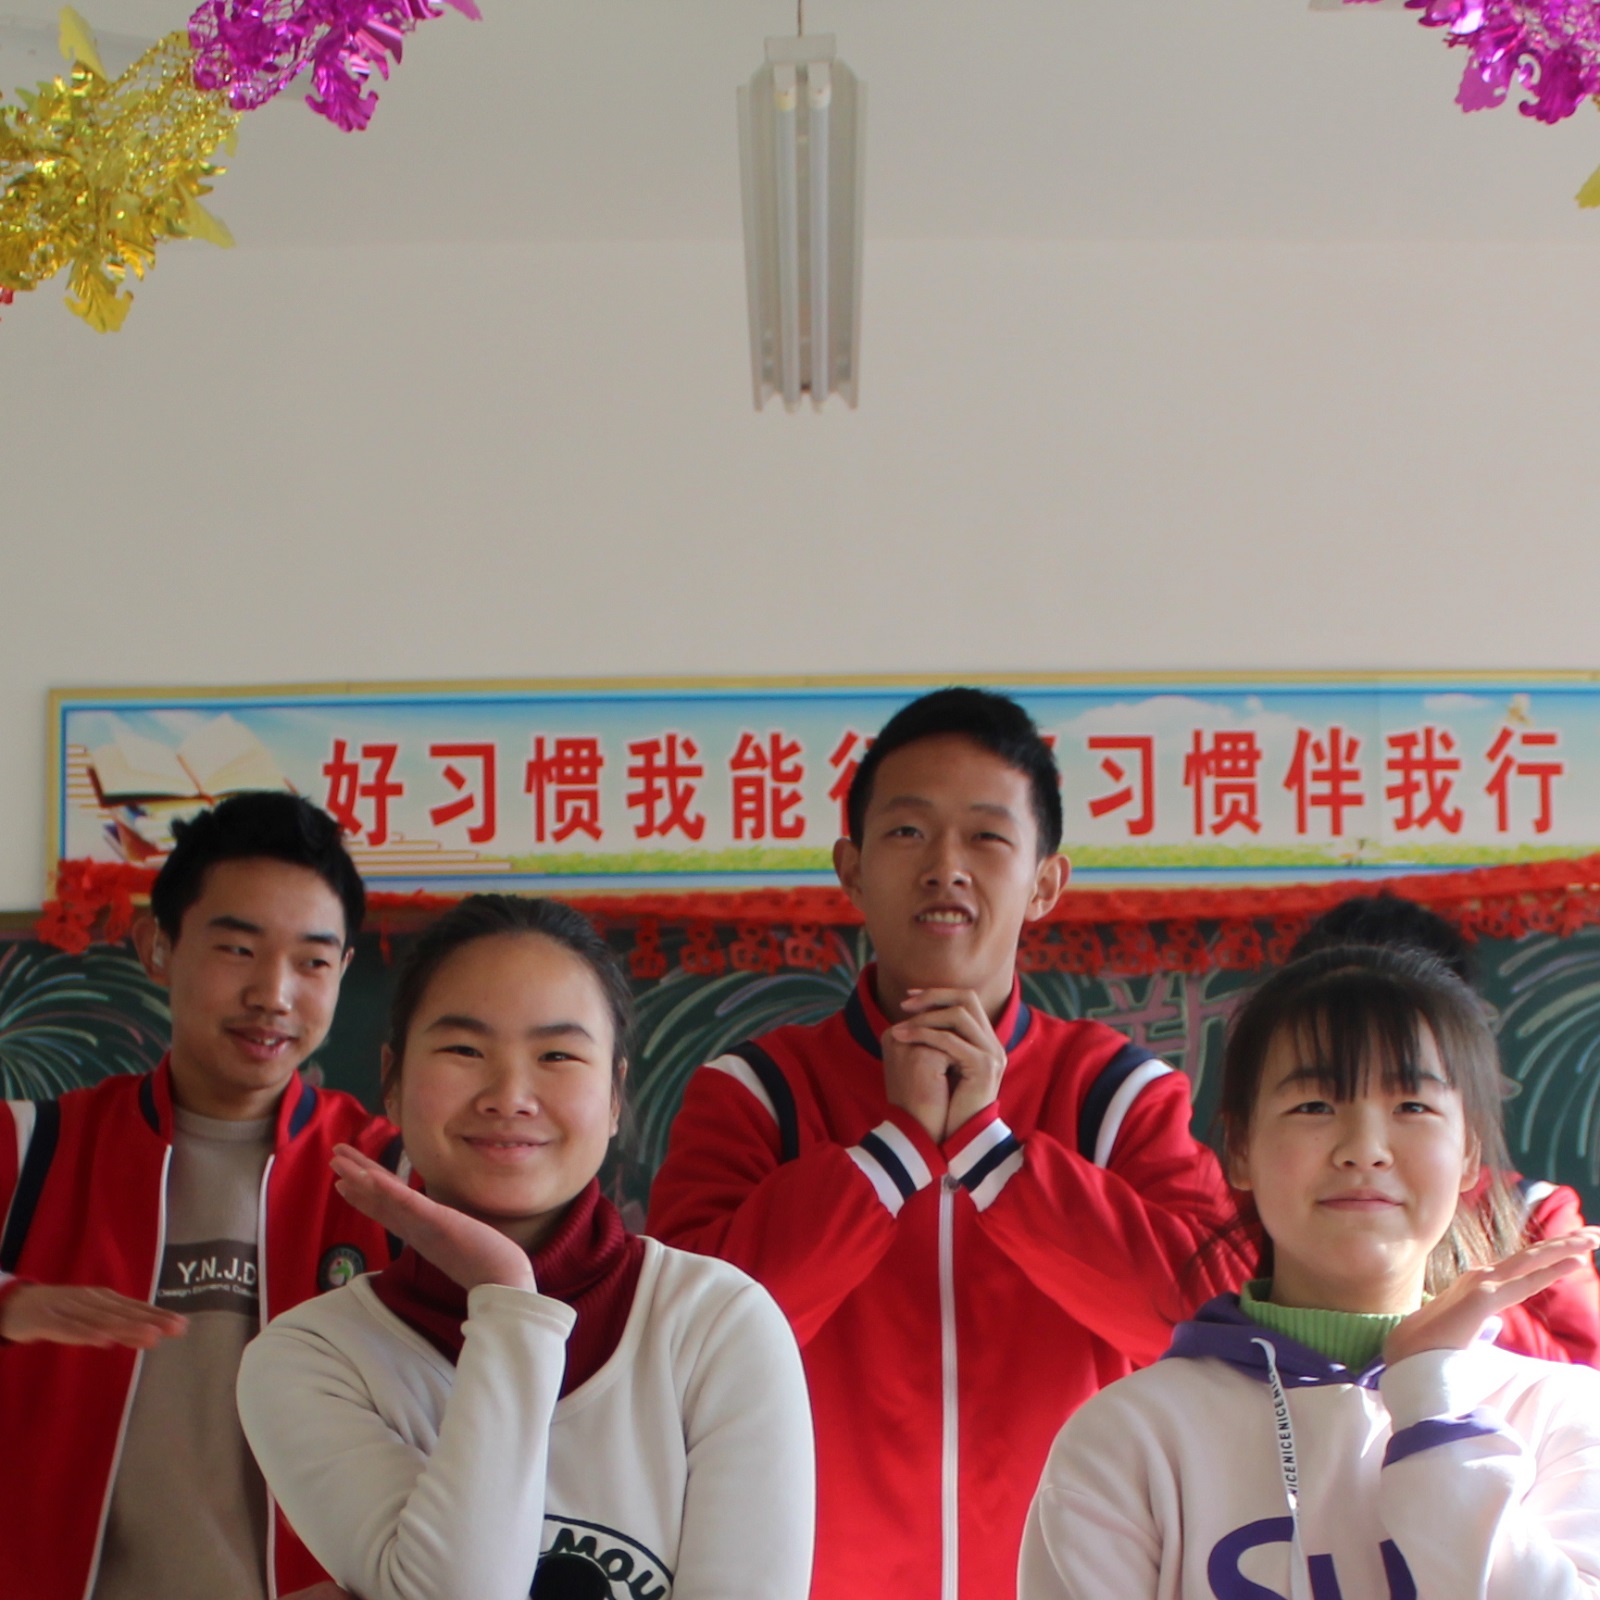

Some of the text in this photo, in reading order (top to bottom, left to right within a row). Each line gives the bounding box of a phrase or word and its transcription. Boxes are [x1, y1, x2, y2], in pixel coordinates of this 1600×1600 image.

[1042, 724, 1563, 836] 习惯伴我行
